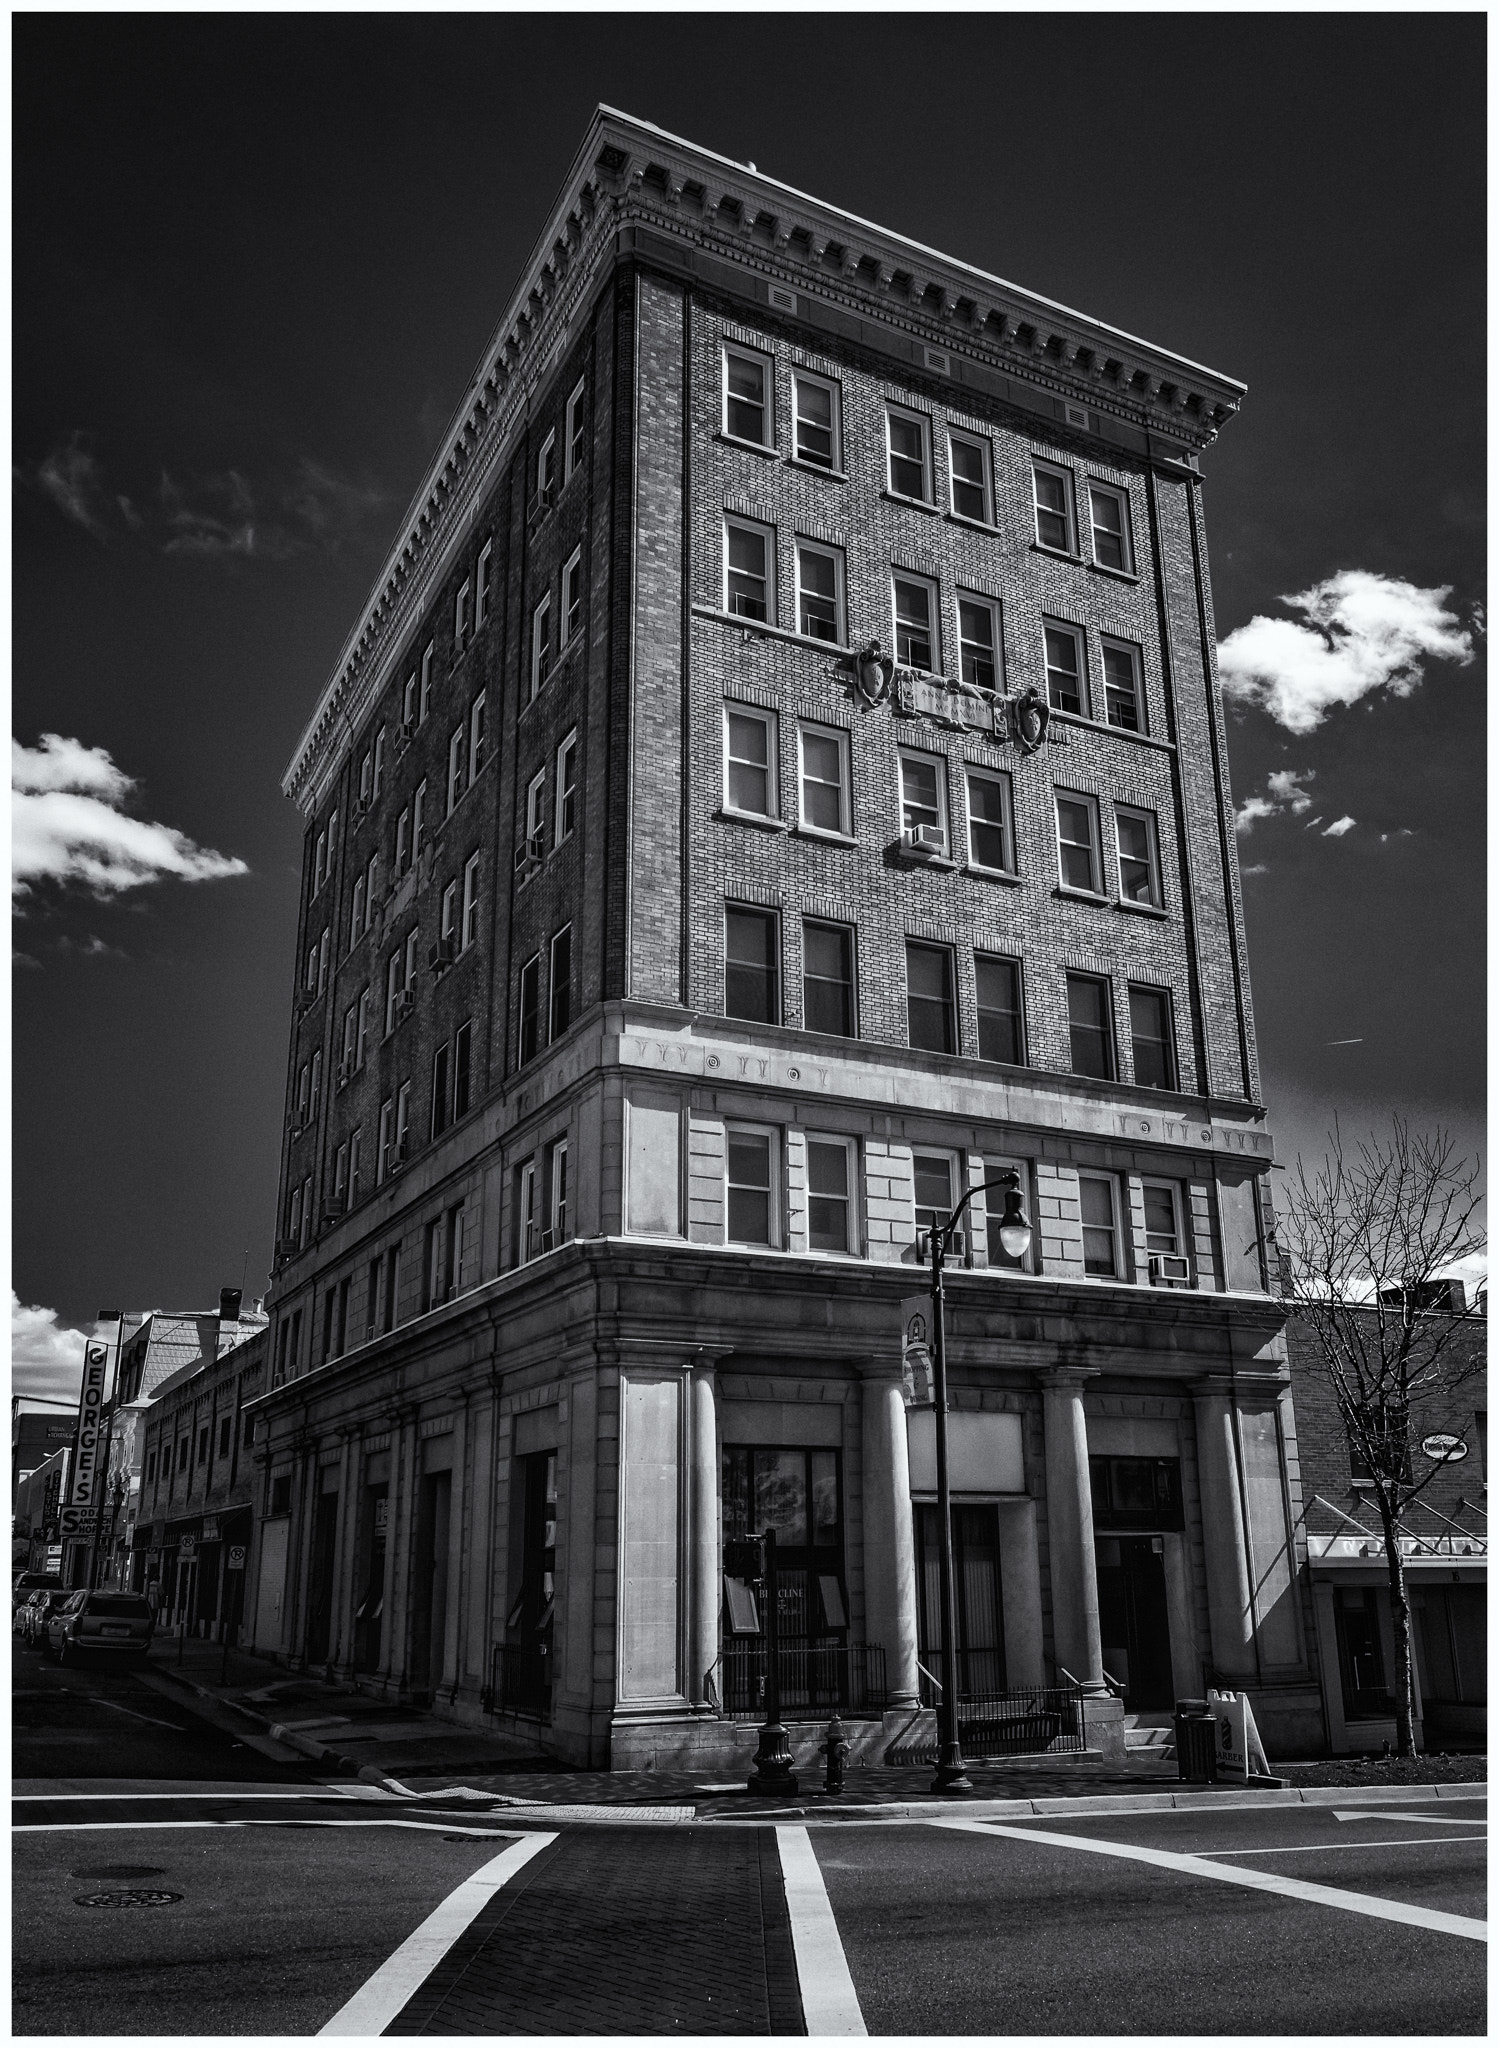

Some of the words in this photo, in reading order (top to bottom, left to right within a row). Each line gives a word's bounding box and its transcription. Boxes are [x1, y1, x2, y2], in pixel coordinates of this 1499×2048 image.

[921, 689, 948, 702] ANNO
[953, 696, 988, 714] DOMINI
[76, 1347, 103, 1502] GEORGE'S
[777, 1588, 804, 1599] CLINE
